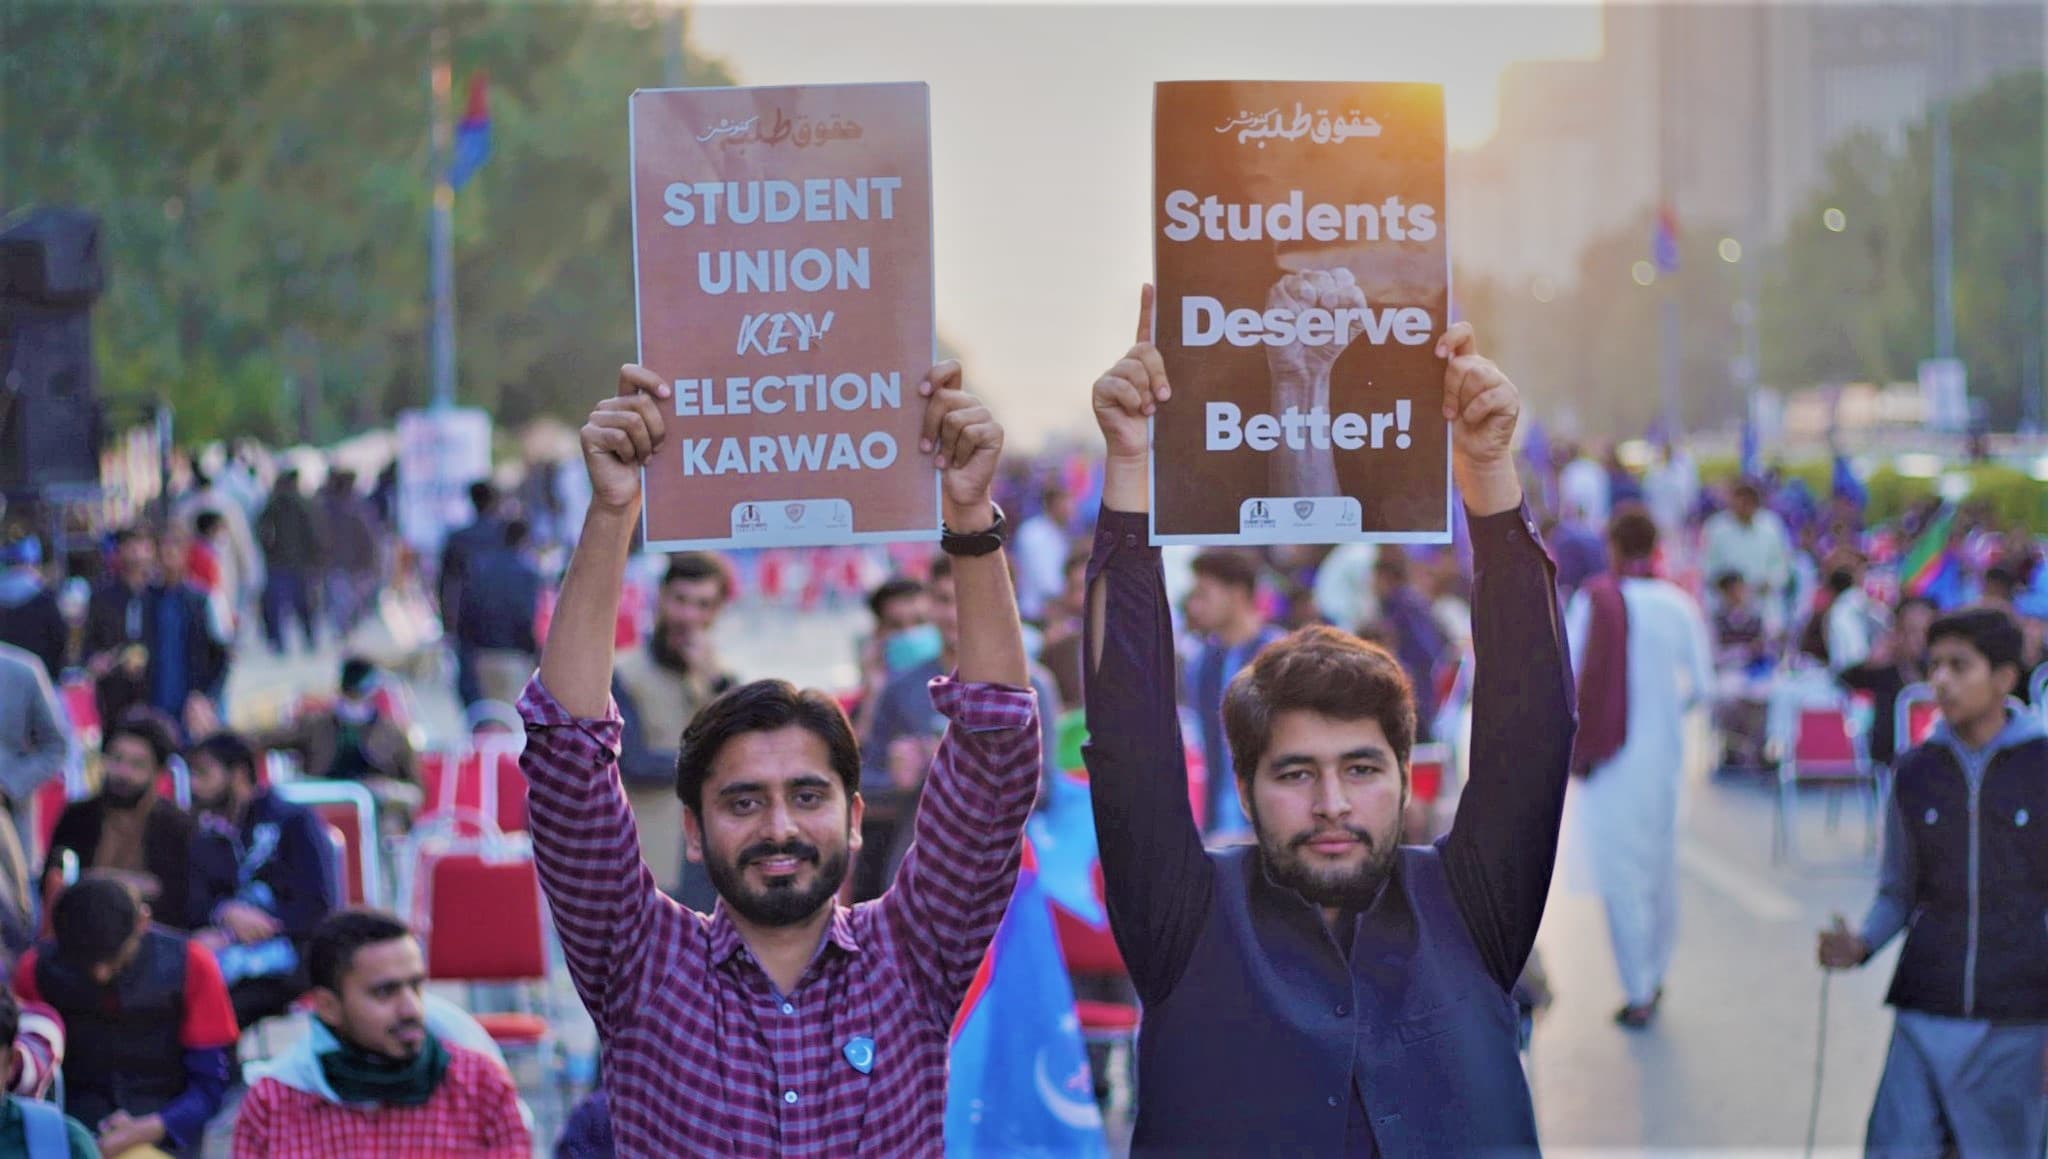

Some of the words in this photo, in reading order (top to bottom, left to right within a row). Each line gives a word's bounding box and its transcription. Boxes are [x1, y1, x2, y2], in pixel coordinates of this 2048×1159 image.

[791, 113, 863, 149] حقوق
[1311, 109, 1382, 144] حقوق
[663, 177, 901, 226] STUDENT
[1163, 190, 1437, 241] Students
[698, 247, 870, 294] UNION
[1182, 296, 1432, 347] Deserve
[674, 372, 901, 416] ELECTION
[1206, 400, 1412, 451] Better!
[682, 431, 897, 476] KARWAO
